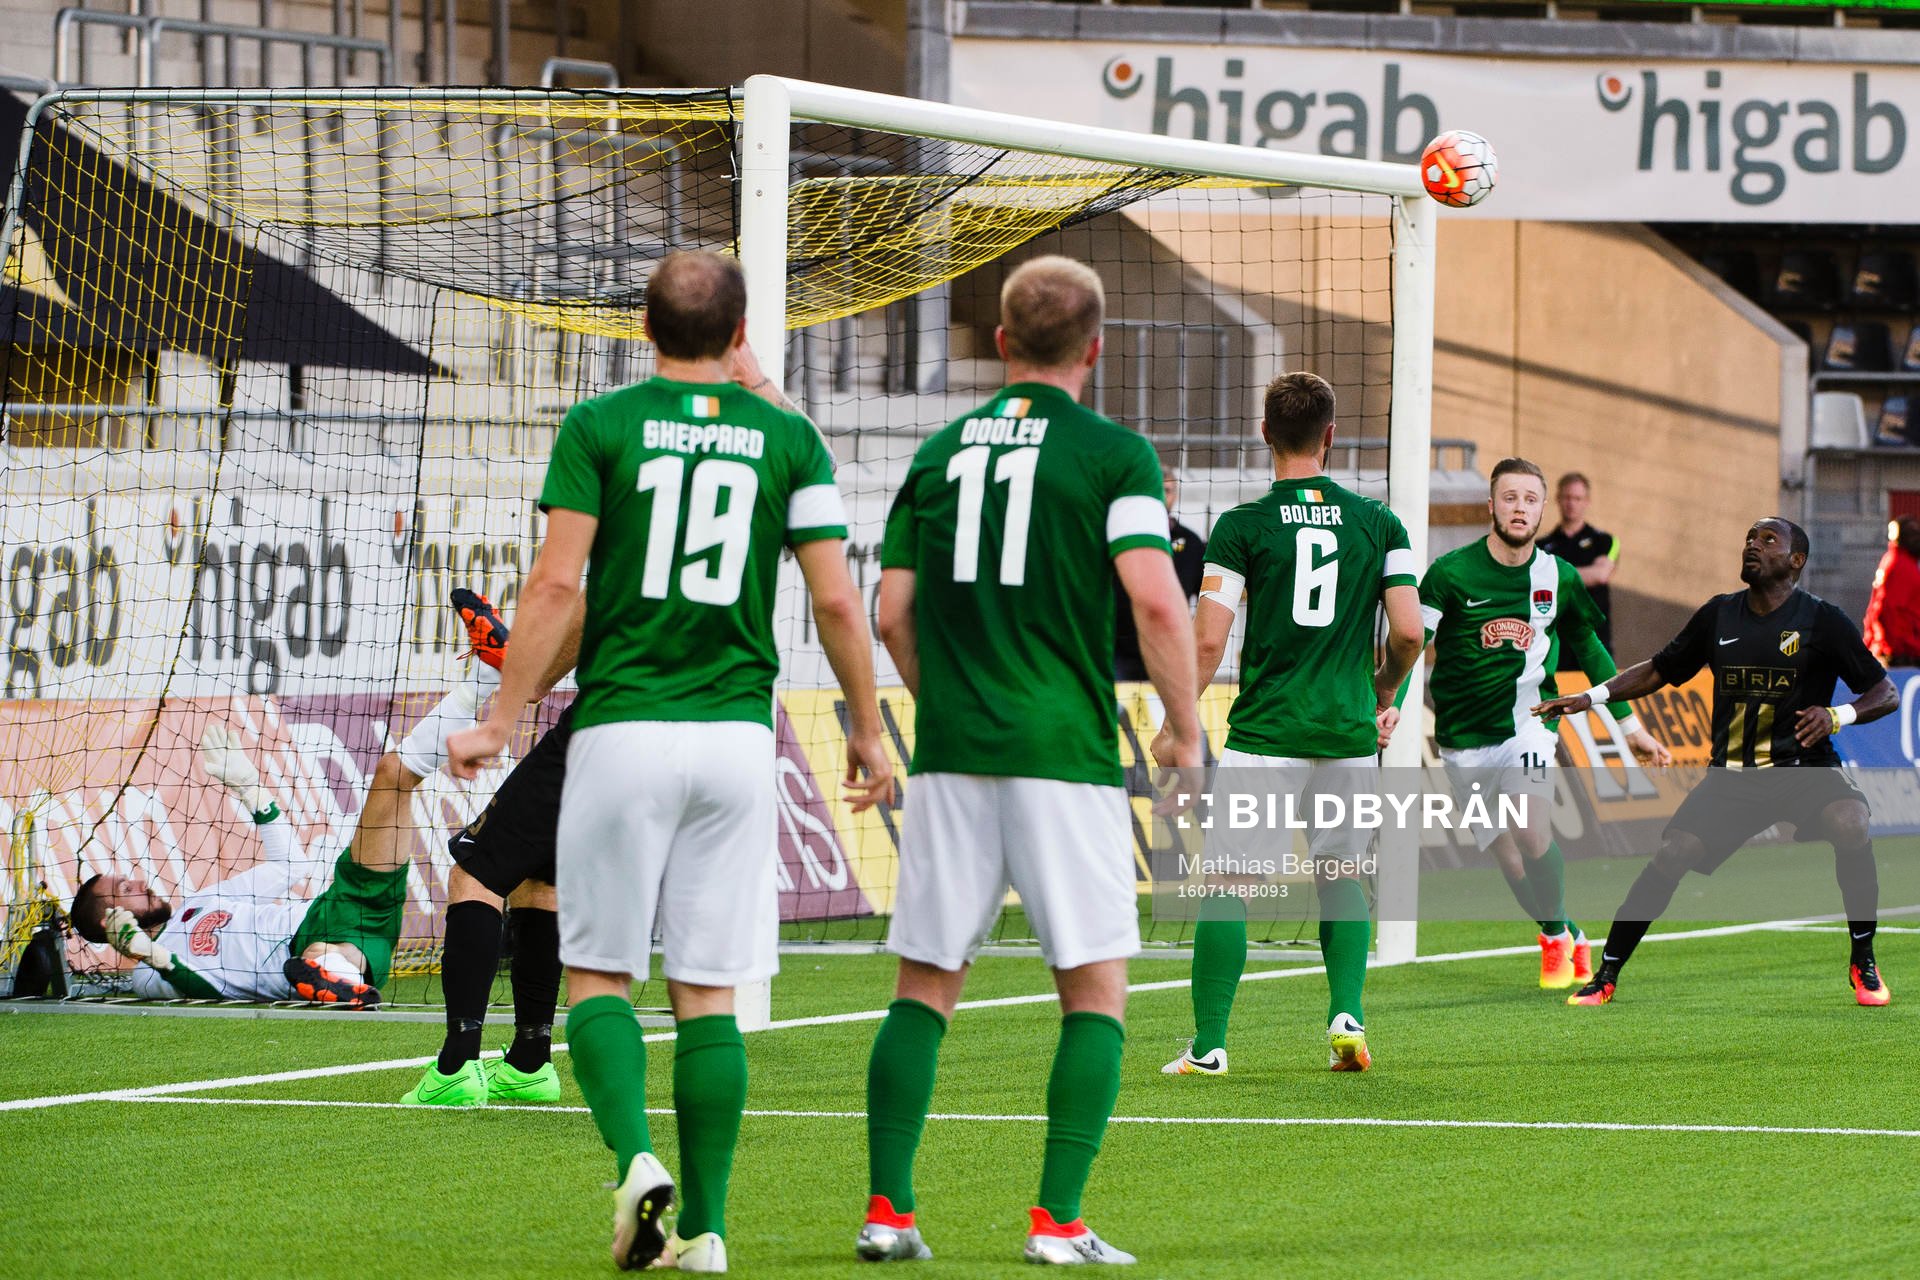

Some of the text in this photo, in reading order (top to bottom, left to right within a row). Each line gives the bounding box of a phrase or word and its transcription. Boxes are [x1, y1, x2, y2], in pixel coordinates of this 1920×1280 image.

[1638, 70, 1907, 206] higab
[643, 419, 764, 459] SHEPPARD
[960, 418, 1049, 445] DOOLEY
[636, 455, 759, 607] 19
[946, 445, 1041, 586] 11
[1279, 505, 1343, 526] BOLGER
[191, 496, 349, 694] higab
[1292, 527, 1339, 627] 6
[1520, 752, 1546, 779] 14
